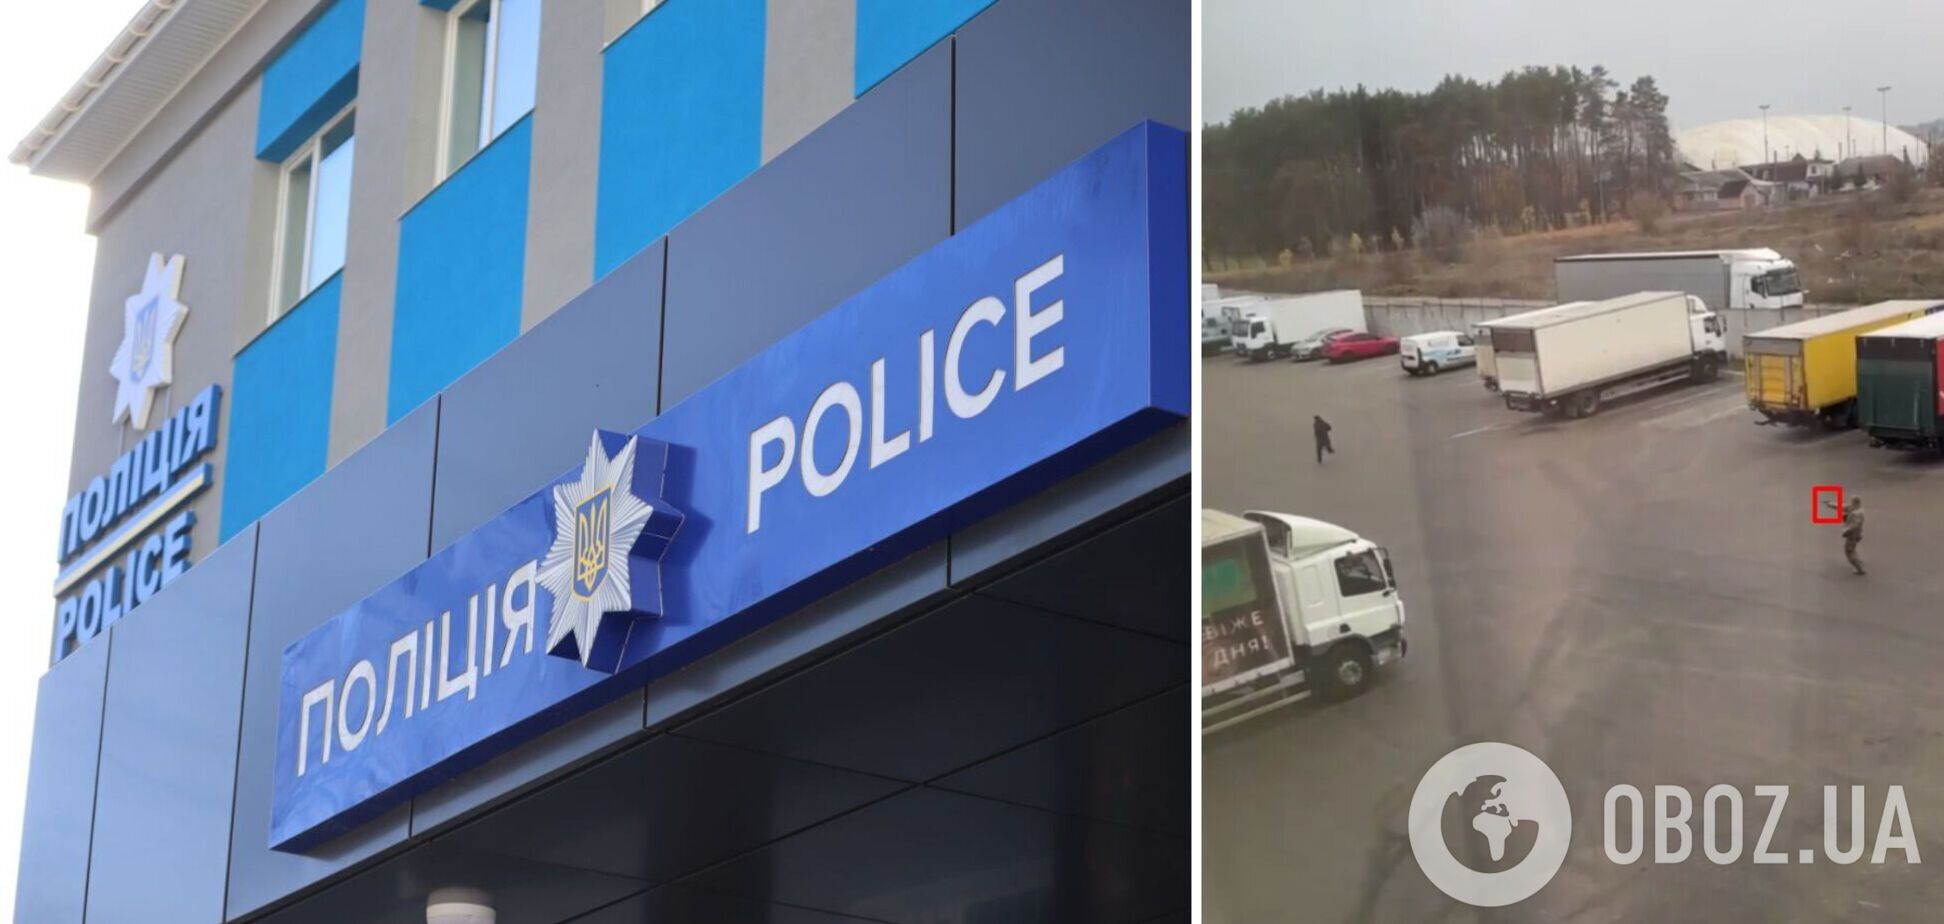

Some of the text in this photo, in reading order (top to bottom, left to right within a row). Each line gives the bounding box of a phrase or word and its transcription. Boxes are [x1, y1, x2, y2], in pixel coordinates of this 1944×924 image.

[58, 384, 220, 564] ПОЛІЦІЯ
[747, 253, 1065, 535] POLICE
[56, 510, 195, 662] POLICE
[298, 559, 538, 777] ПОЛІЦІЯ
[1202, 610, 1264, 642] ВІЖЕ
